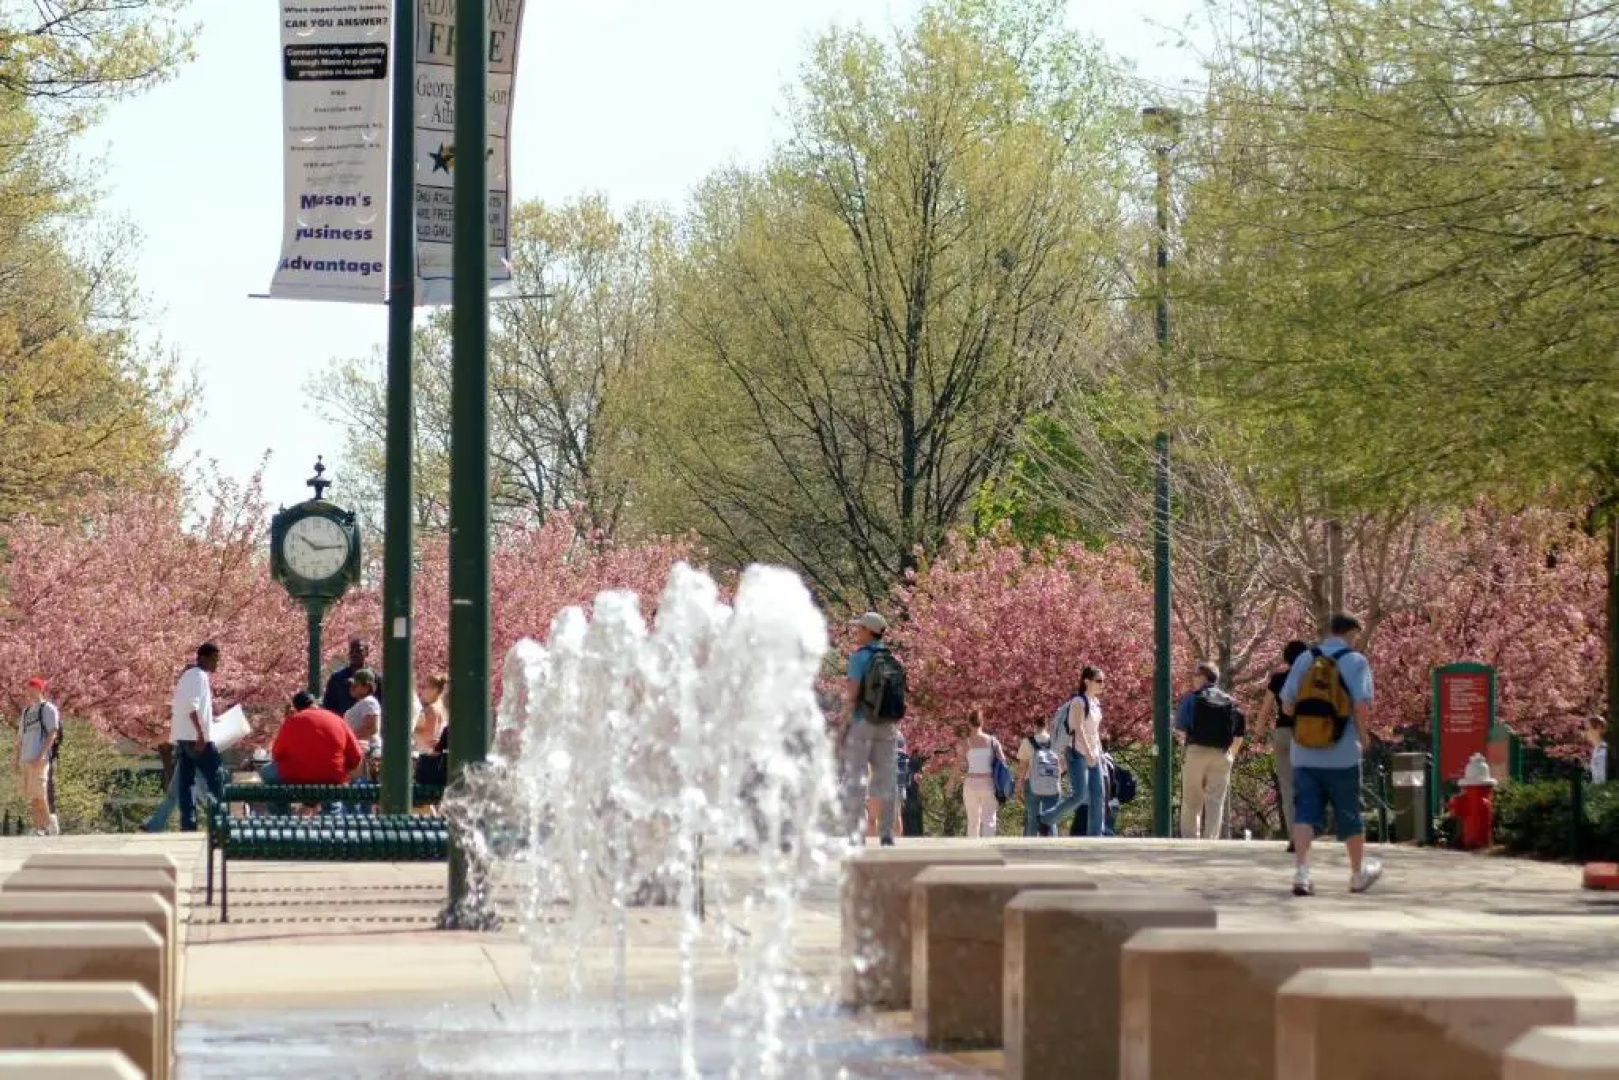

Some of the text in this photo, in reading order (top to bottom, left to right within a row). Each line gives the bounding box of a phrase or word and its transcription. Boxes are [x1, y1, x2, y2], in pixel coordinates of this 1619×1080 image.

[285, 16, 388, 28] CAN YOU ANSWER?
